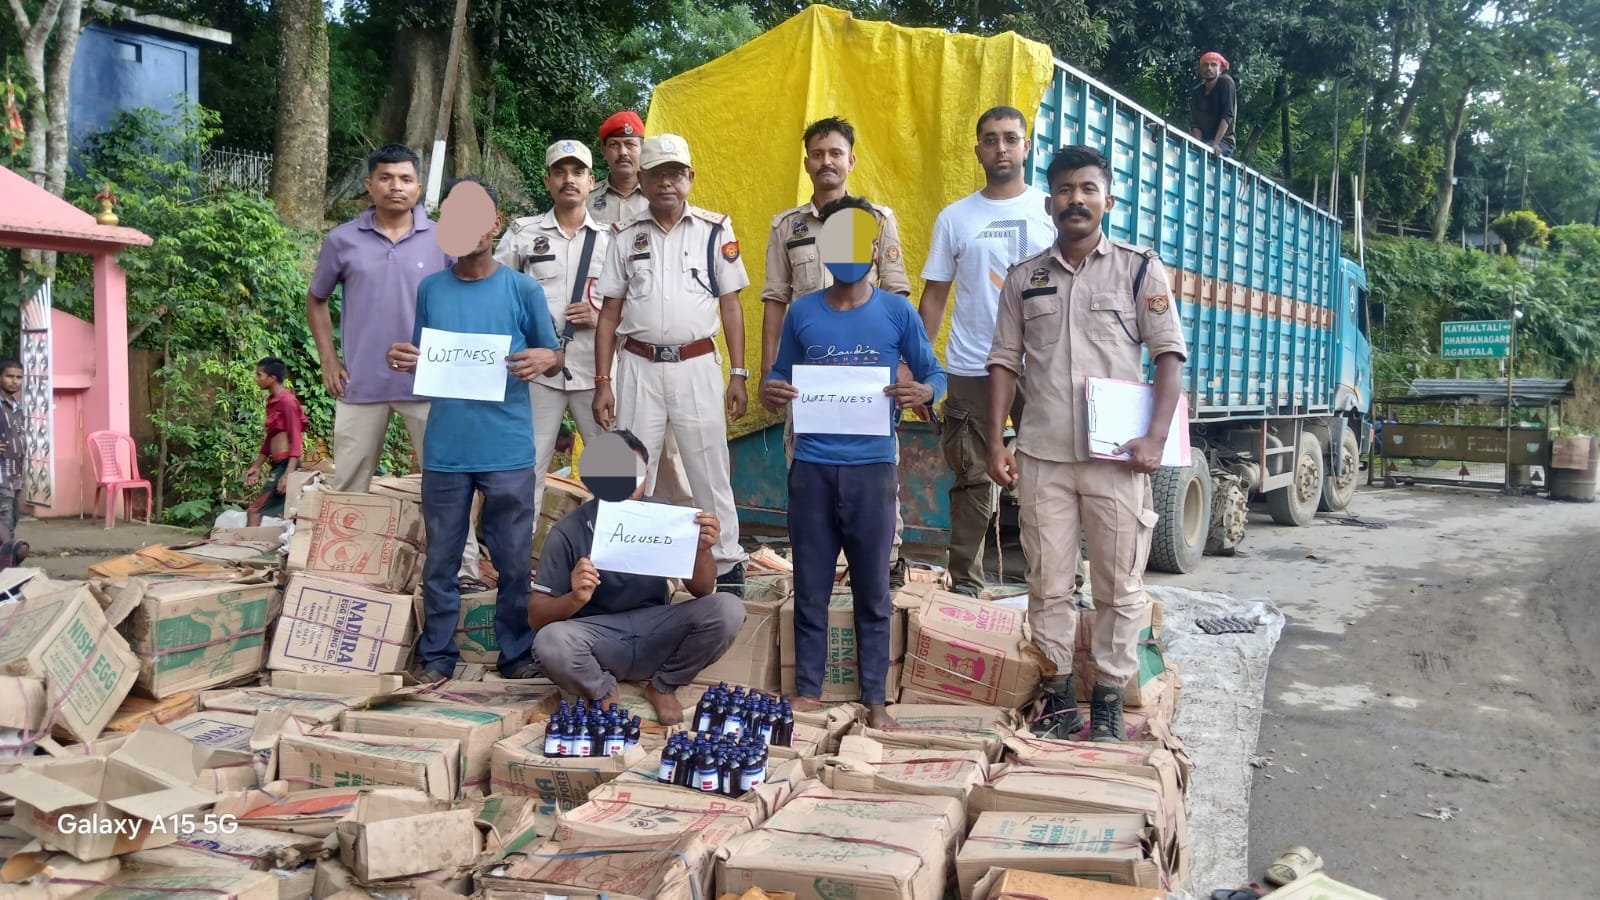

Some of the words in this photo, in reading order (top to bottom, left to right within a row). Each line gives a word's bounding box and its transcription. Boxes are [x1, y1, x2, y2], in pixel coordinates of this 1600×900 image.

[984, 231, 1012, 239] CASUAL
[1444, 323, 1502, 333] KATHALTALI
[1444, 335, 1505, 345] DHARMANAGAR
[427, 346, 496, 365] WITNESS
[1444, 347, 1494, 357] AGARTALA
[801, 393, 873, 404] WITNESS
[609, 522, 673, 545] ACCUSED
[339, 598, 349, 614] EGG
[337, 600, 368, 663] NADIRA
[831, 627, 840, 645] EGG
[93, 654, 117, 690] EGG
[192, 726, 237, 742] DIRA
